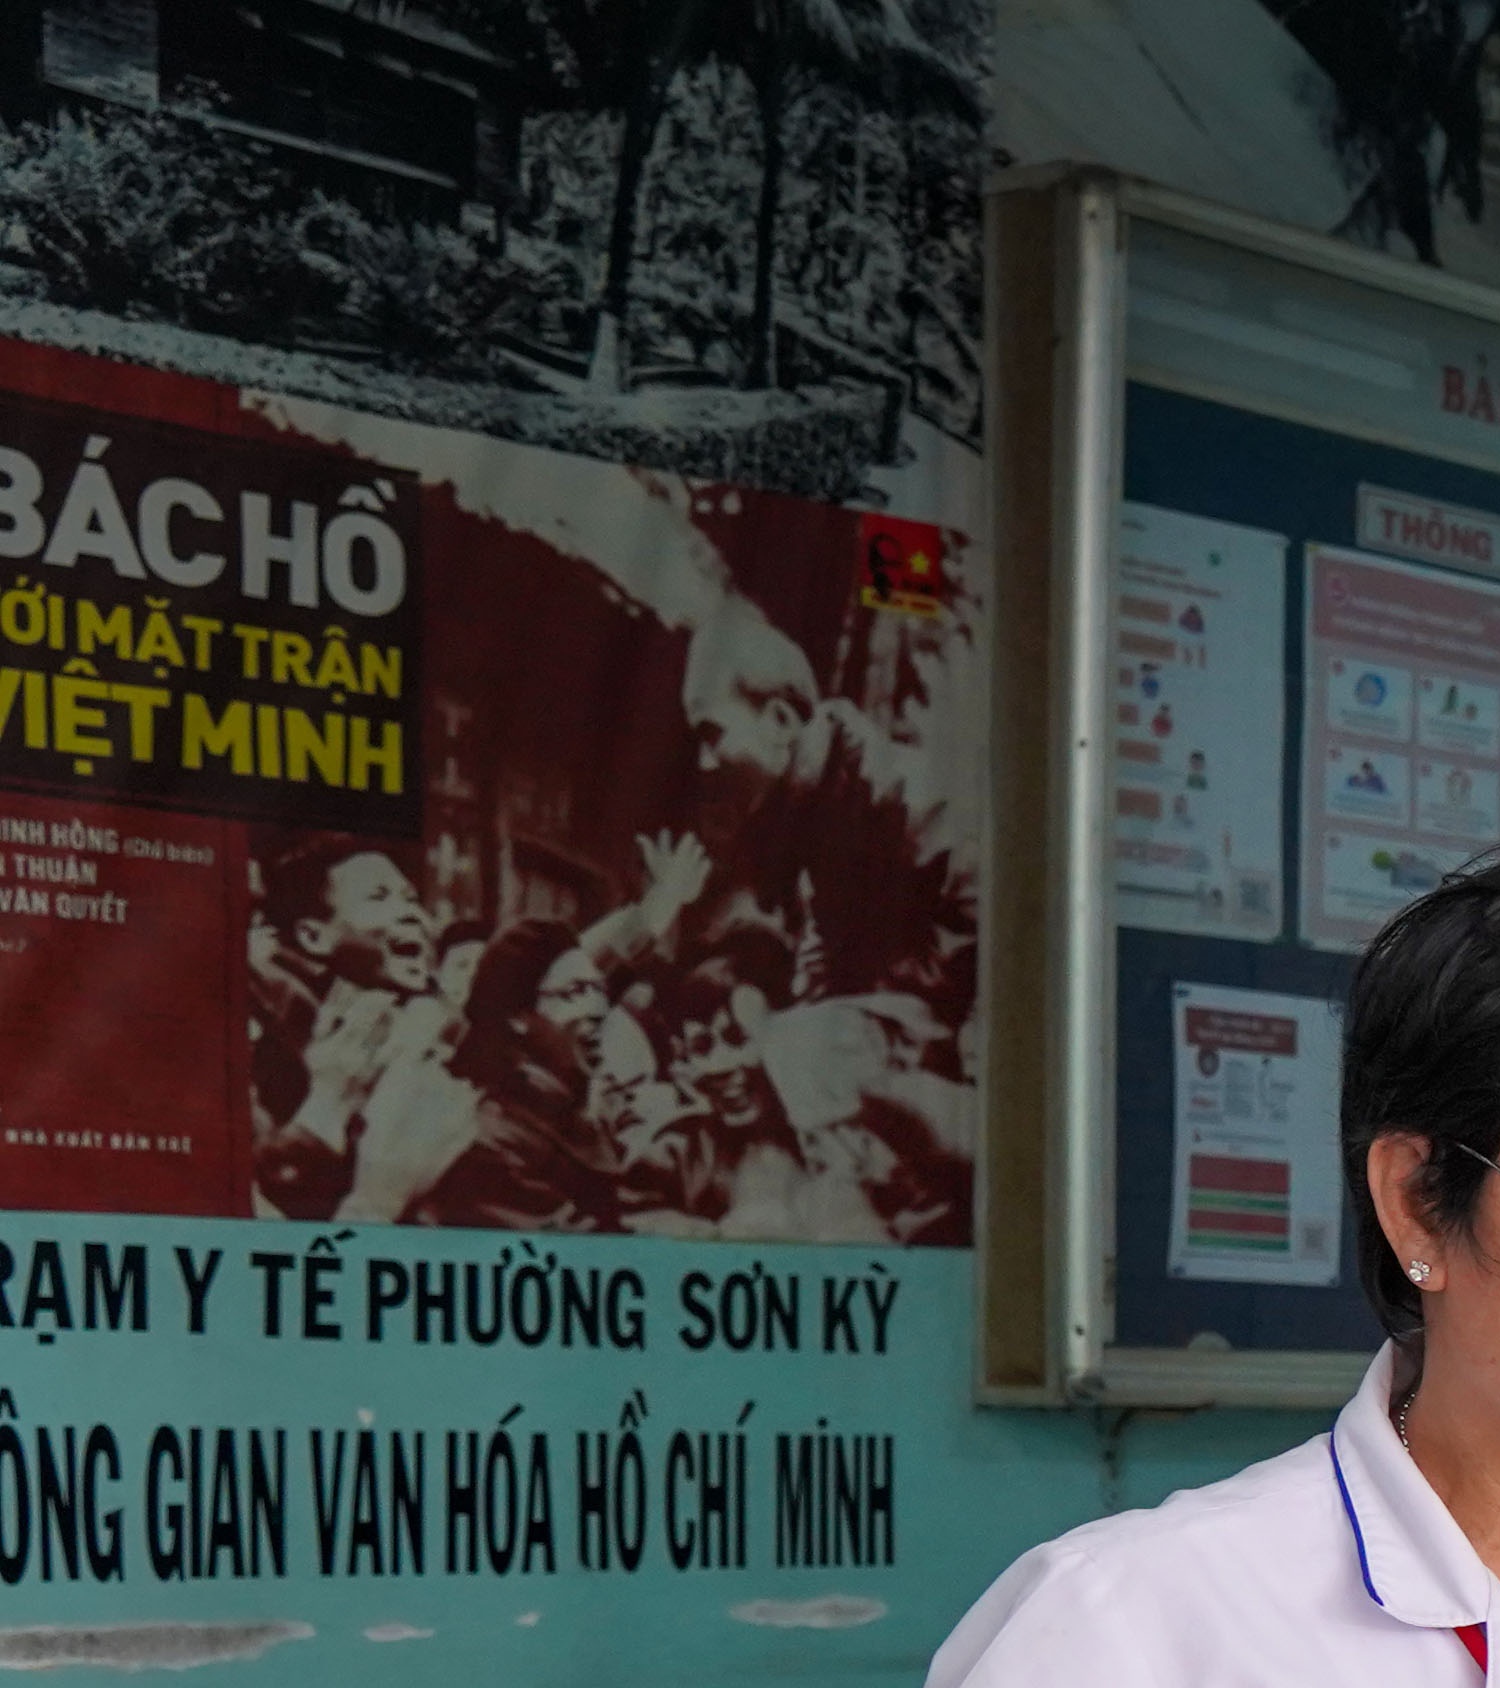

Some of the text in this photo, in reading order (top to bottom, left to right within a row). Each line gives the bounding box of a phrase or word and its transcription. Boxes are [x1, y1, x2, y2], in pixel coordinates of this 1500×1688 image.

[0, 434, 408, 617] BÁC HỒ
[77, 595, 401, 701] MẶT TRẬN
[181, 694, 403, 794] MINH
[174, 1247, 223, 1335] Y
[250, 1230, 356, 1341] TẾ
[367, 1240, 645, 1351] PHƯỜNG
[678, 1261, 799, 1352] SƠN
[823, 1261, 900, 1354] KỲ
[146, 1425, 287, 1582] GIAN
[445, 1402, 556, 1577] HÓA
[575, 1388, 648, 1573] HỒ
[666, 1402, 756, 1571] CHÍ
[775, 1417, 895, 1568] MINH
